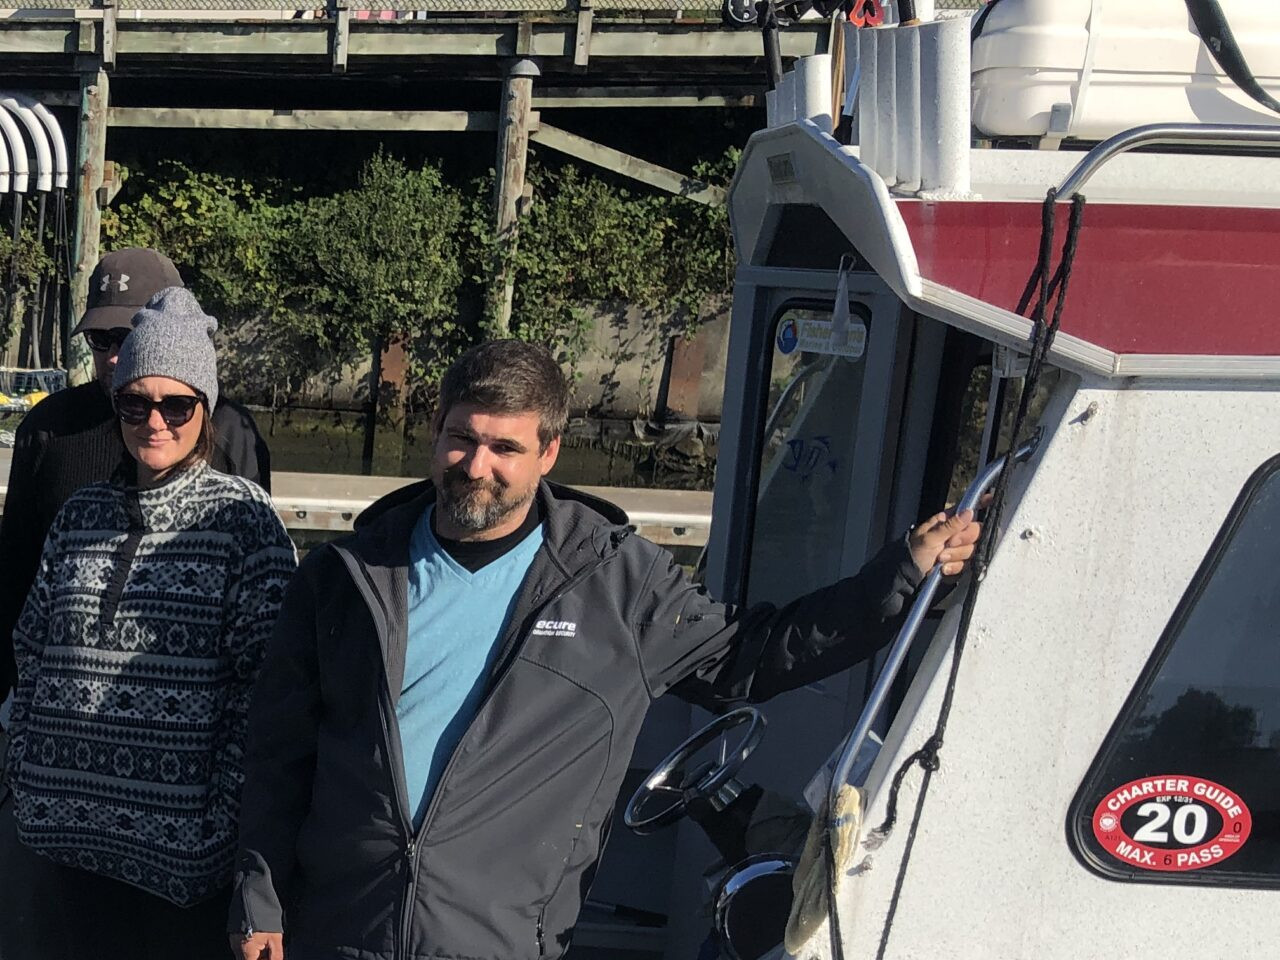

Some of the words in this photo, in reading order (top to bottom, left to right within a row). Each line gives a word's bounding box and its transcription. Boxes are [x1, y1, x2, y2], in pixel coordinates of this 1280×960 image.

[1107, 778, 1190, 811] CHARTER
[1193, 782, 1243, 819] GUIDE
[1132, 801, 1209, 845] 20
[1116, 840, 1157, 866] MAX.
[1162, 854, 1172, 866] 6
[1177, 844, 1224, 867] PASS
